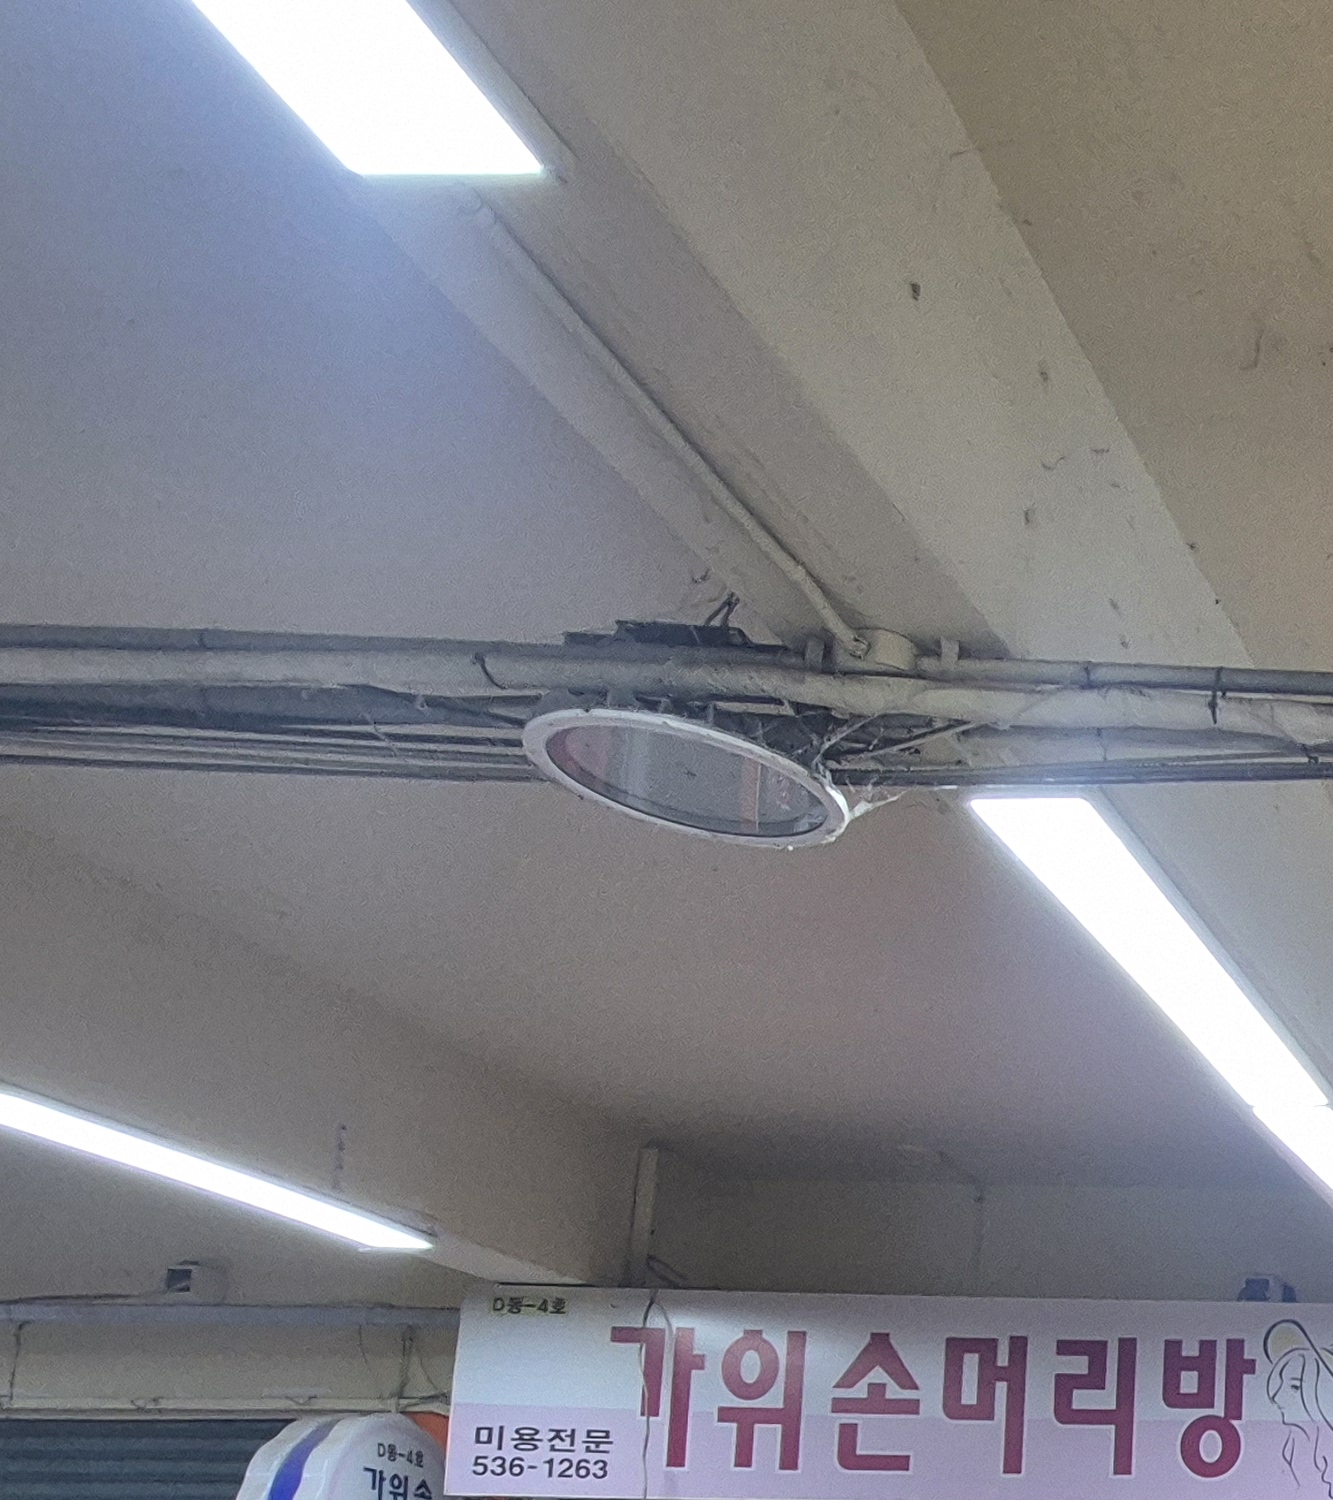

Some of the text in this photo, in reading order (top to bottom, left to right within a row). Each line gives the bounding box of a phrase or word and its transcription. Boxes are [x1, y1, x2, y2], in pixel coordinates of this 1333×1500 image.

[610, 1325, 1257, 1478] 가위손머리방
[473, 1424, 614, 1454] 미용전문
[471, 1455, 609, 1480] 536-1263
